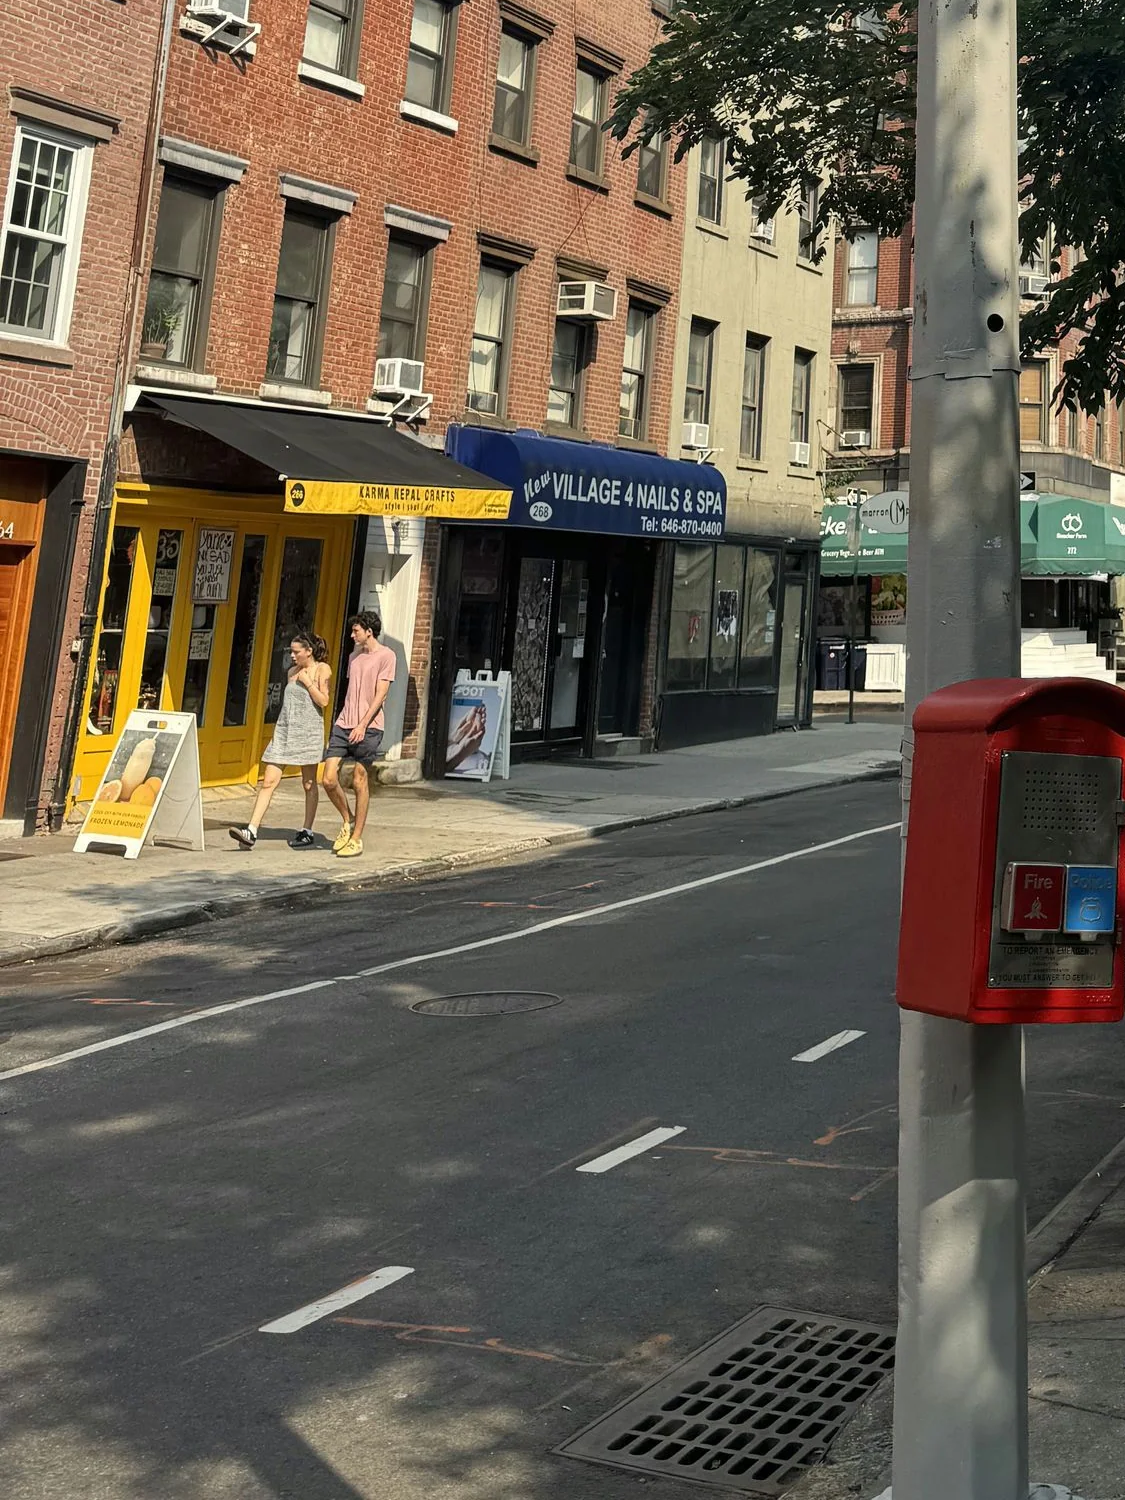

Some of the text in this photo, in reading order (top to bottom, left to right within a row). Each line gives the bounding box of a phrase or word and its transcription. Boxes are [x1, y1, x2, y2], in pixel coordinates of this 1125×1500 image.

[359, 485, 455, 503] KARMA NEPAL CRAFTS
[523, 470, 551, 503] New
[553, 472, 723, 515] VILLAGE 4 NAILS & SPA
[532, 505, 549, 518] 268
[862, 508, 889, 517] marron
[640, 515, 722, 536] Tel: 646-870-0400
[89, 817, 144, 829] FROZEN LEMONADE
[1024, 873, 1053, 889] Fire
[1003, 946, 1013, 955] TO
[1014, 946, 1042, 955] REPORT
[1045, 947, 1055, 955] AN
